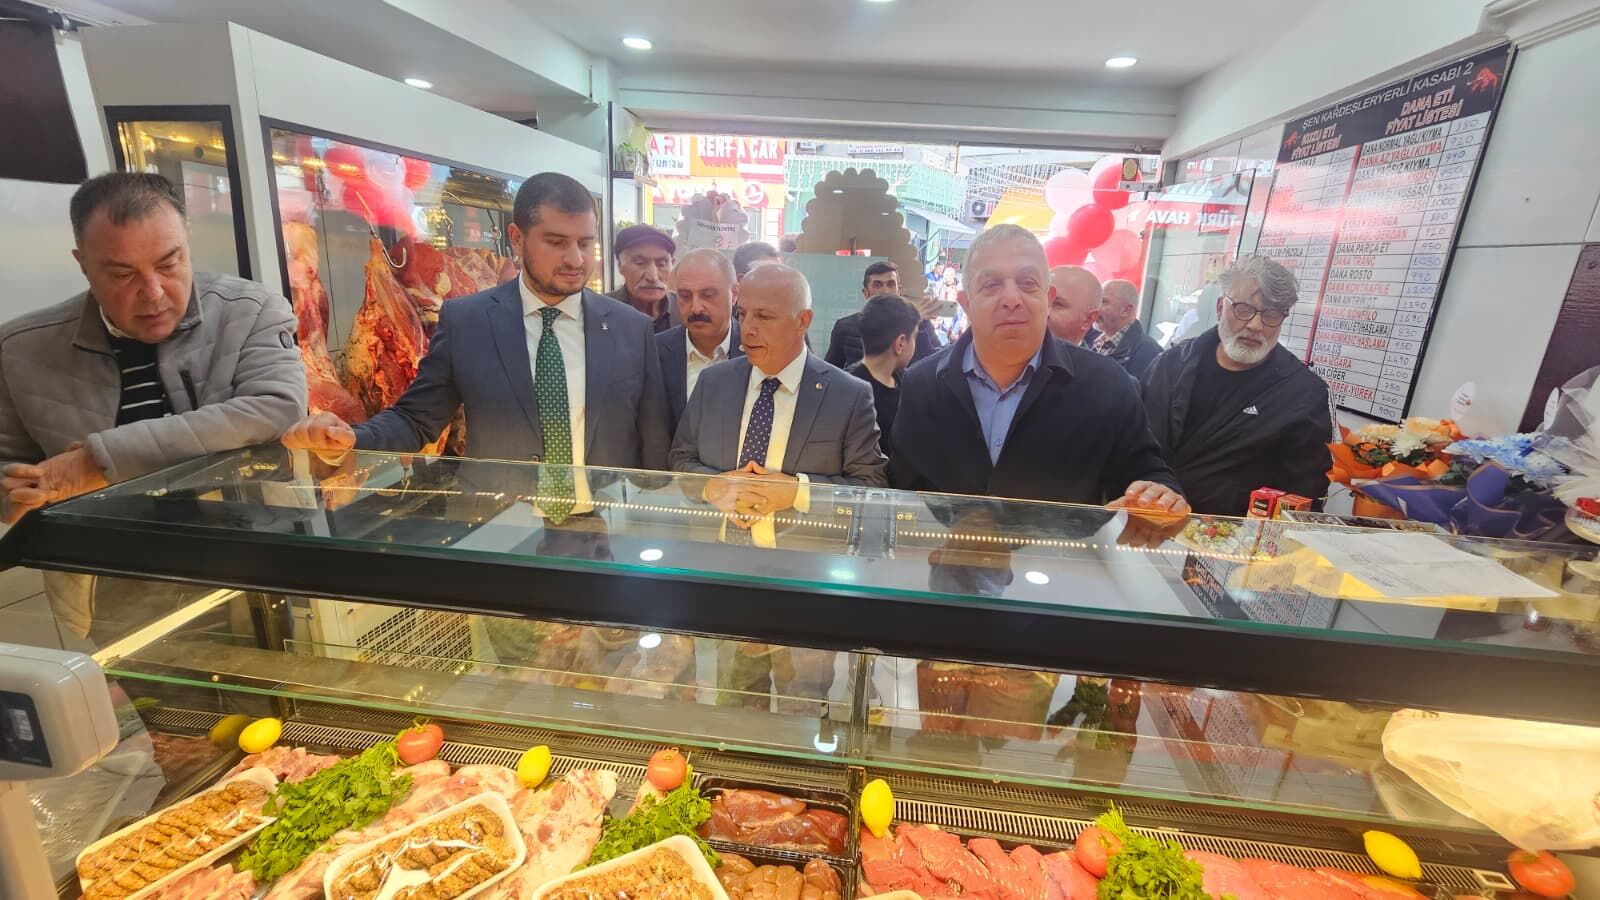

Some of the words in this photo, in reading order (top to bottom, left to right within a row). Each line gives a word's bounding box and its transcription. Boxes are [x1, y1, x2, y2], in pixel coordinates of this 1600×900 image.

[1412, 67, 1462, 92] KASABI
[1463, 61, 1475, 76] 2
[1400, 94, 1433, 117] DANA
[1385, 113, 1418, 136] FİYAT
[1405, 158, 1430, 171] KIYMA
[1330, 270, 1348, 278] DANA
[1349, 270, 1373, 279] ROSTO
